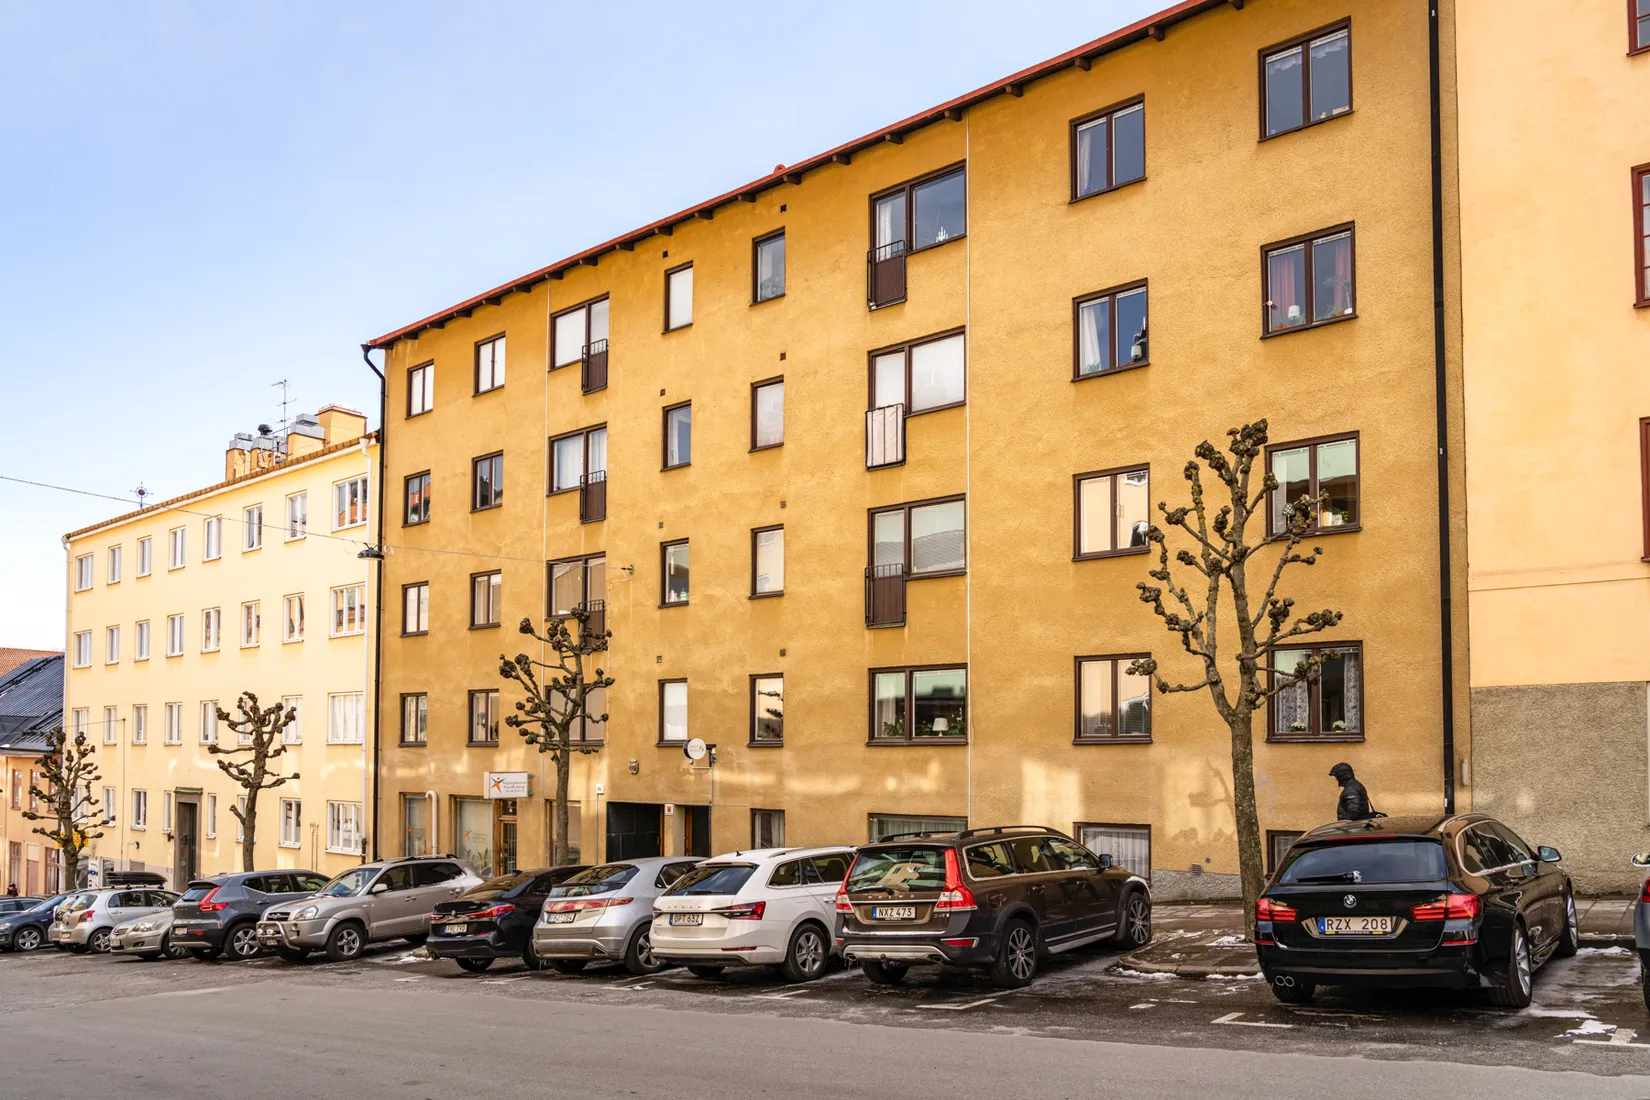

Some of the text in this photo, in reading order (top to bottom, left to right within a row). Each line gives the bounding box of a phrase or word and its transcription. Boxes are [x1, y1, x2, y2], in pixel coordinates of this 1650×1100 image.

[878, 907, 912, 917] NXZ 473
[1326, 919, 1388, 930] RZX 208
